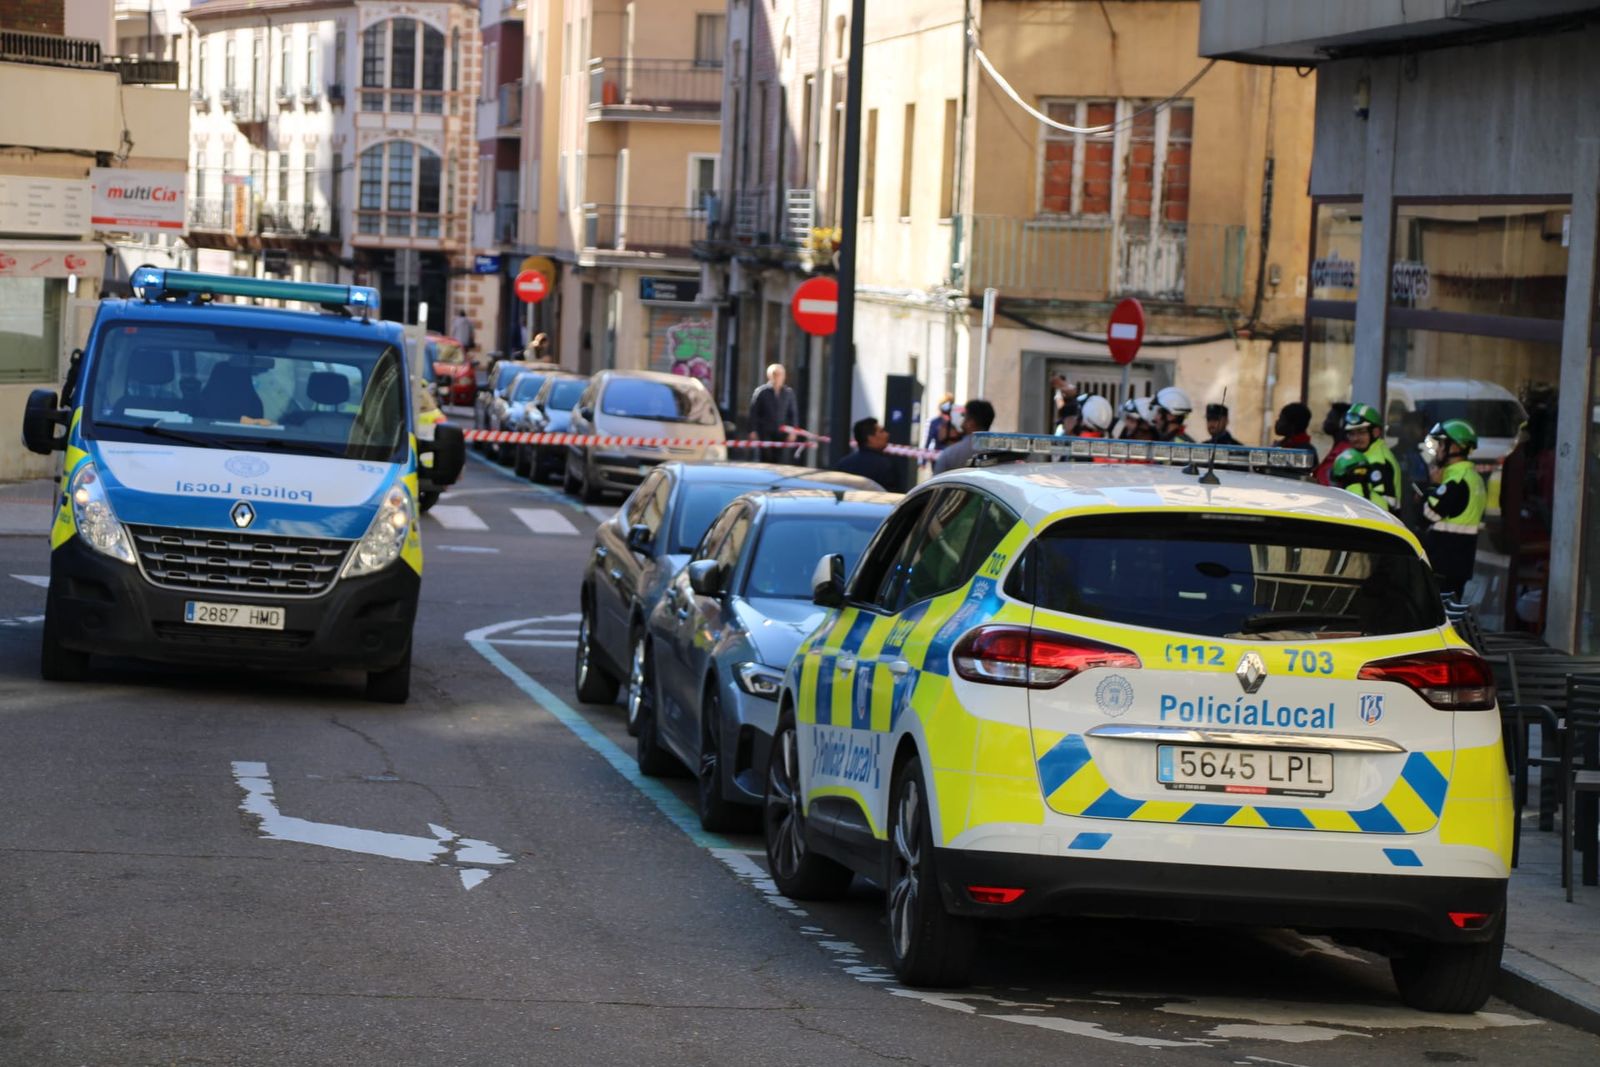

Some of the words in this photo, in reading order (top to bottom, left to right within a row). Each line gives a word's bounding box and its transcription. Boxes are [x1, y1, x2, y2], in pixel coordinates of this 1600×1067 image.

[199, 606, 239, 623] 2887
[249, 608, 280, 626] HMD
[1175, 645, 1226, 666] 112
[1284, 649, 1335, 674] 703
[843, 734, 873, 783] Local
[1180, 751, 1257, 780] 5645
[1268, 755, 1324, 784] LPL
